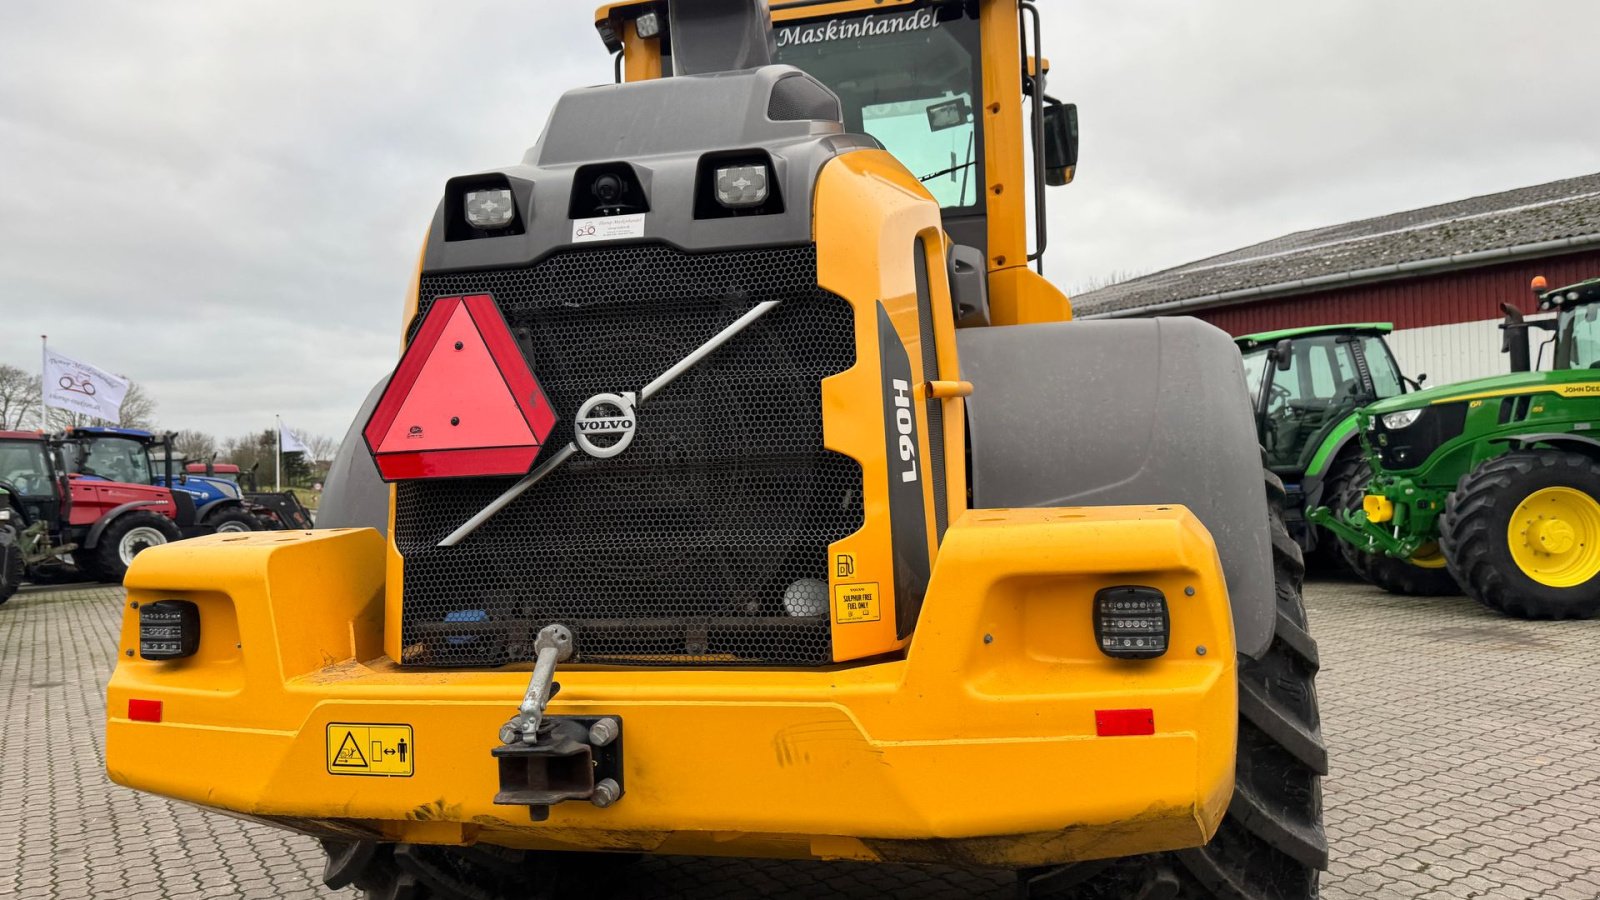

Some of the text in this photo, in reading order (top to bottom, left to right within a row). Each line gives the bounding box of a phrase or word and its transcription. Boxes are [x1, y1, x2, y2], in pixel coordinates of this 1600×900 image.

[777, 7, 942, 47] Maskinhandel
[577, 420, 633, 430] VOLVO
[892, 378, 918, 483] L90H
[862, 593, 872, 601] FREE
[847, 602, 857, 610] FUEL
